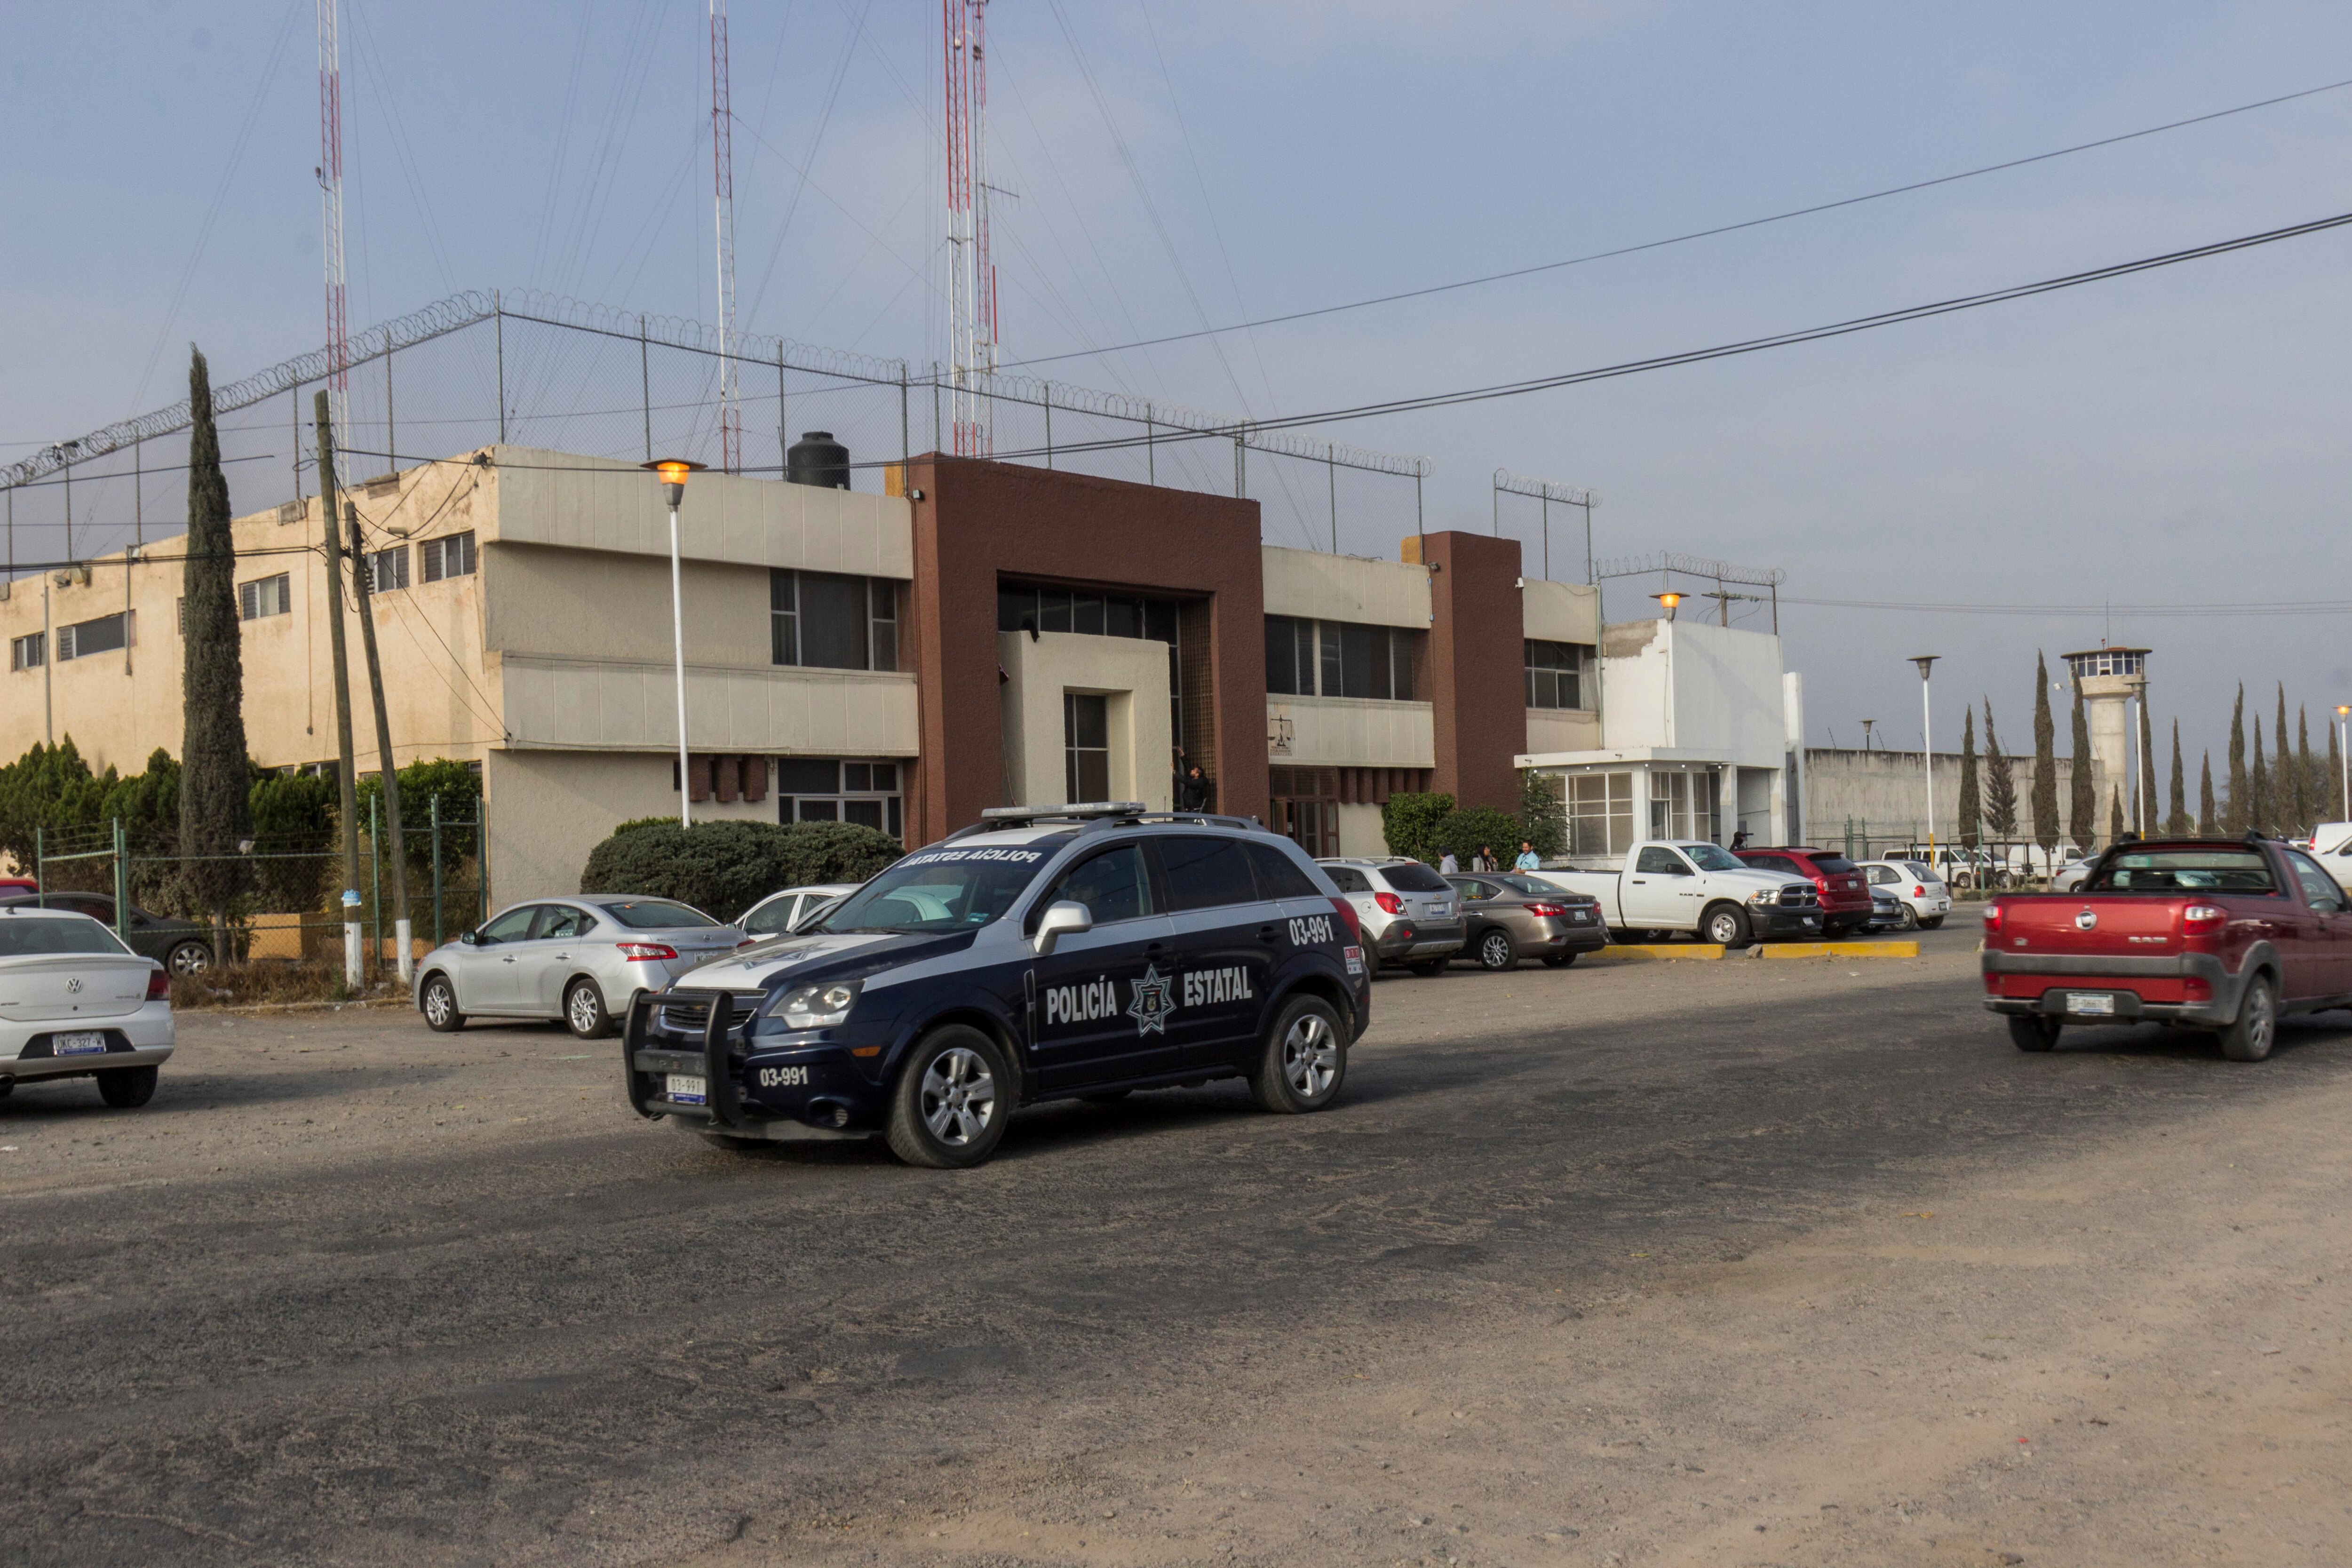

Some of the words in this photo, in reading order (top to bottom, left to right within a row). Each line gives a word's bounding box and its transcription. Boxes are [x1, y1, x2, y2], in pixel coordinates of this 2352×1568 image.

[1289, 915, 1334, 946] 03-991
[1346, 949, 1359, 958] 911
[1047, 975, 1117, 1024] POLICÍA
[1184, 966, 1252, 1007] ESTATAL
[760, 1066, 808, 1086] 03-991
